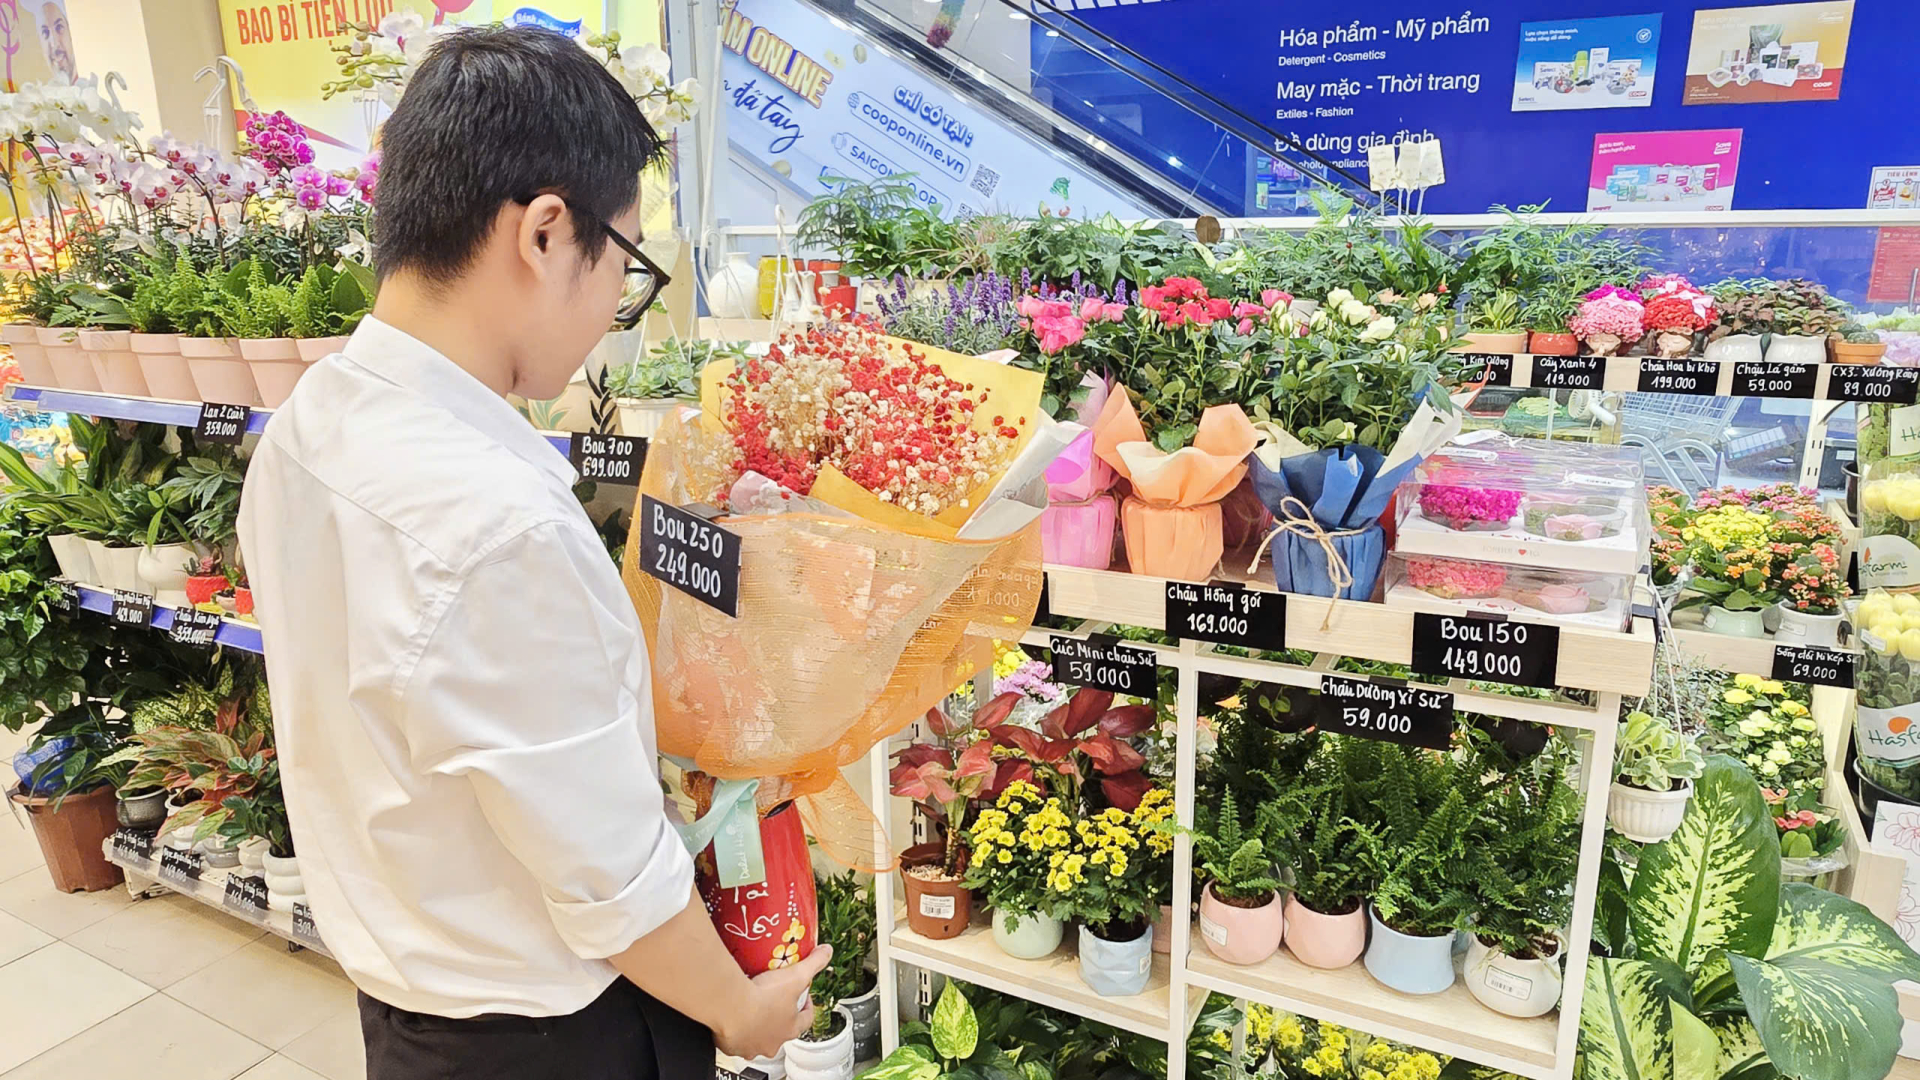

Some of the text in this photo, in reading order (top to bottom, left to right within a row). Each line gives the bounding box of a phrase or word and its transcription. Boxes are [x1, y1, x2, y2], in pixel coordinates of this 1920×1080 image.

[236, 6, 274, 45] BAO
[1280, 28, 1317, 47] Hóa
[1323, 20, 1377, 48] phẩm
[1395, 18, 1426, 41] Mỹ
[1431, 11, 1490, 40] phẩm
[745, 26, 834, 109] ONLINE
[1278, 54, 1325, 66] Detergent
[1333, 50, 1386, 63] Cosmetics
[1276, 81, 1315, 102] May
[1320, 78, 1360, 100] mặc
[1377, 73, 1422, 93] Thời
[1428, 73, 1480, 93] trang
[894, 85, 923, 113] CHỈ
[920, 102, 944, 126] CÓ
[1276, 109, 1308, 119] Extiles
[1316, 106, 1354, 118] Fashion
[758, 95, 804, 154] tay
[862, 103, 965, 175] cooponline.vn
[1306, 133, 1352, 154] dùng
[1357, 132, 1386, 153] gia
[1540, 357, 1597, 372] Cây Xanh 4
[1666, 361, 1684, 372] Hoa
[1737, 363, 1765, 376] Chậu
[1767, 363, 1783, 374] Lá
[1544, 373, 1590, 386] 119.000
[1651, 375, 1697, 389] 199.000
[1748, 378, 1793, 391] 59.000
[1843, 381, 1892, 397] 89.000
[219, 404, 227, 418] 2
[204, 420, 237, 436] 359.000
[581, 435, 633, 456] Bou 700
[581, 456, 630, 478] 699.000
[653, 503, 723, 559] Bou 250
[655, 543, 721, 598] 249.000
[1167, 584, 1263, 614] Chậu Hồng gói
[1186, 612, 1248, 636] 169.000
[1440, 617, 1528, 645] Bou 150
[1050, 637, 1075, 656] Cúc
[1440, 646, 1522, 677] 149.000
[1793, 663, 1837, 680] 69.000
[1069, 661, 1131, 689] 59.000
[1342, 707, 1412, 734] 59.000
